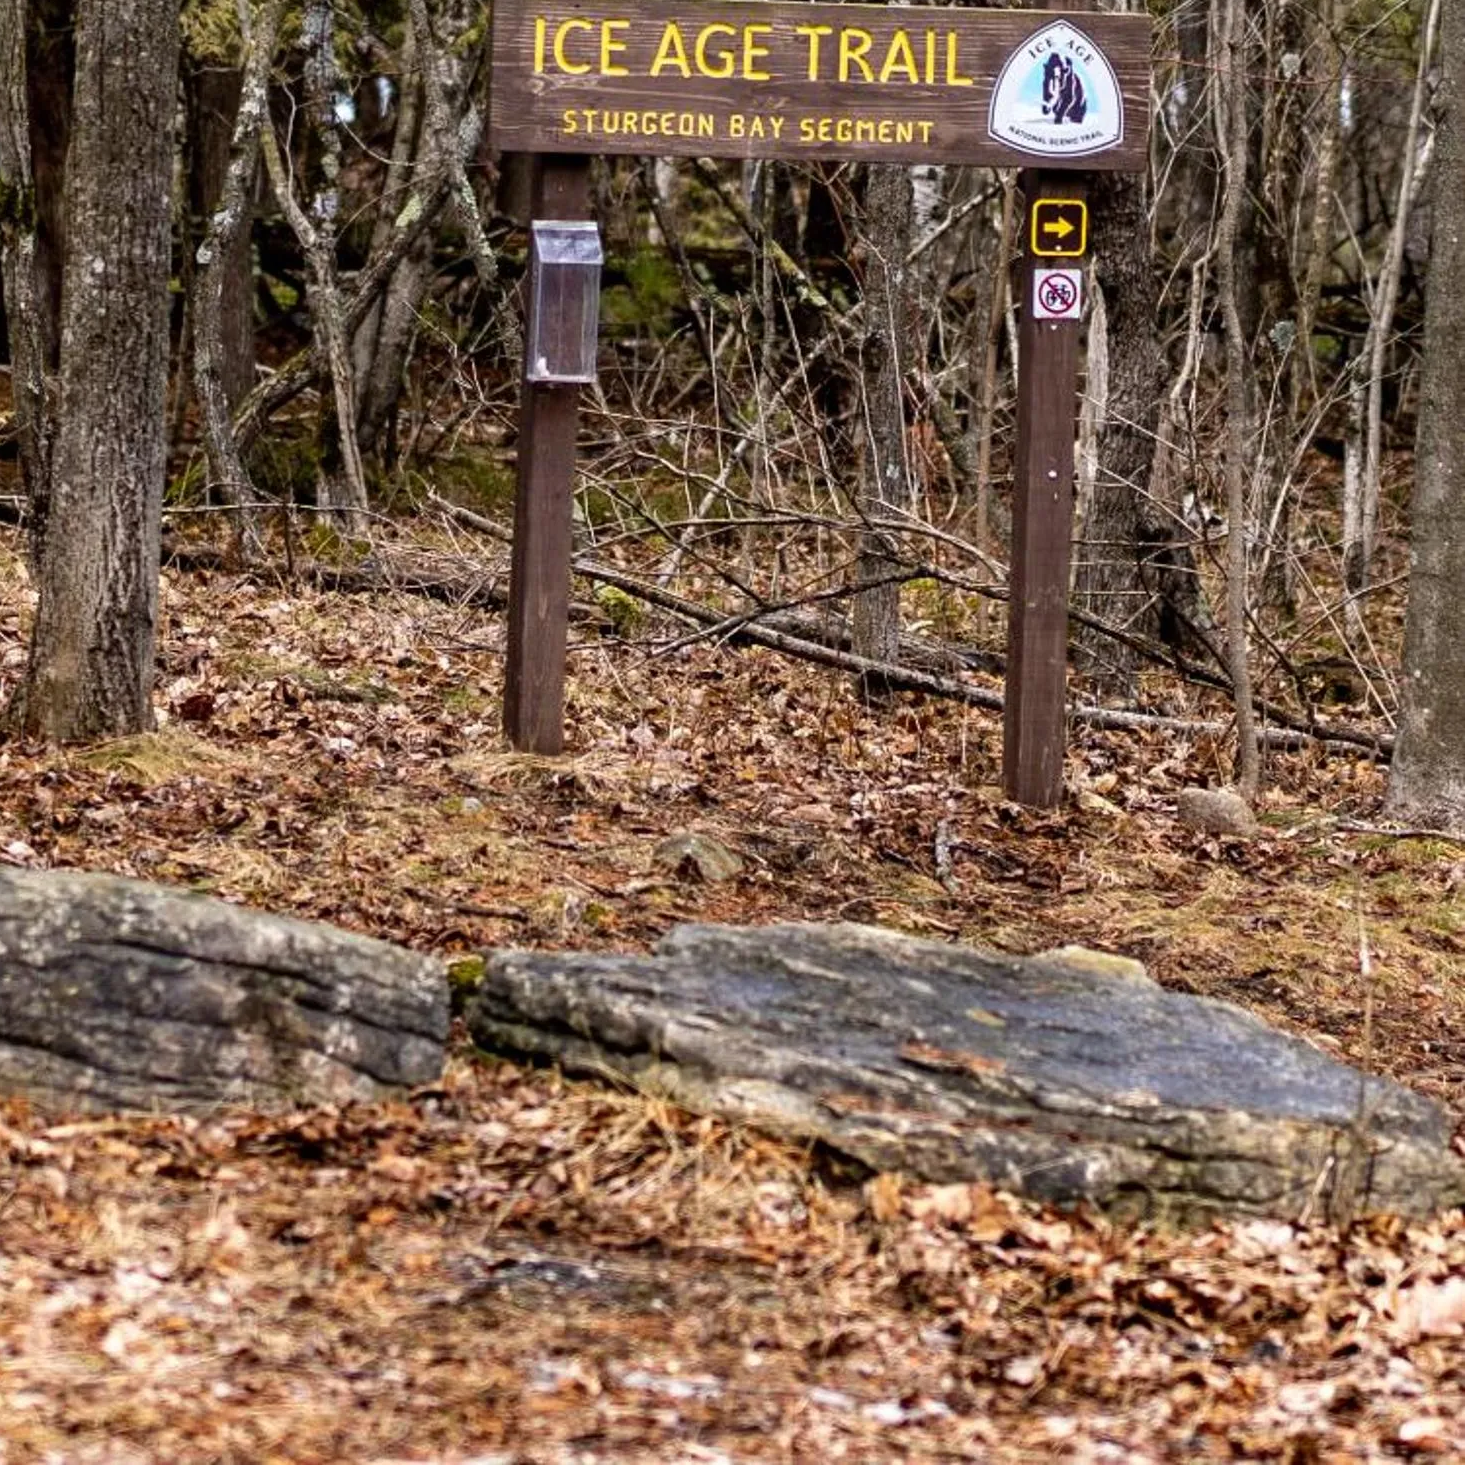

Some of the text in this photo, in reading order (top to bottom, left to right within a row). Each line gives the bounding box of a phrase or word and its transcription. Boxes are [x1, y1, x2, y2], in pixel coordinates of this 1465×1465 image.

[534, 17, 973, 86] ICE AGE TRAIL
[1028, 36, 1094, 64] ICE AGE
[562, 110, 934, 144] STURGEON BAY SEGMENT
